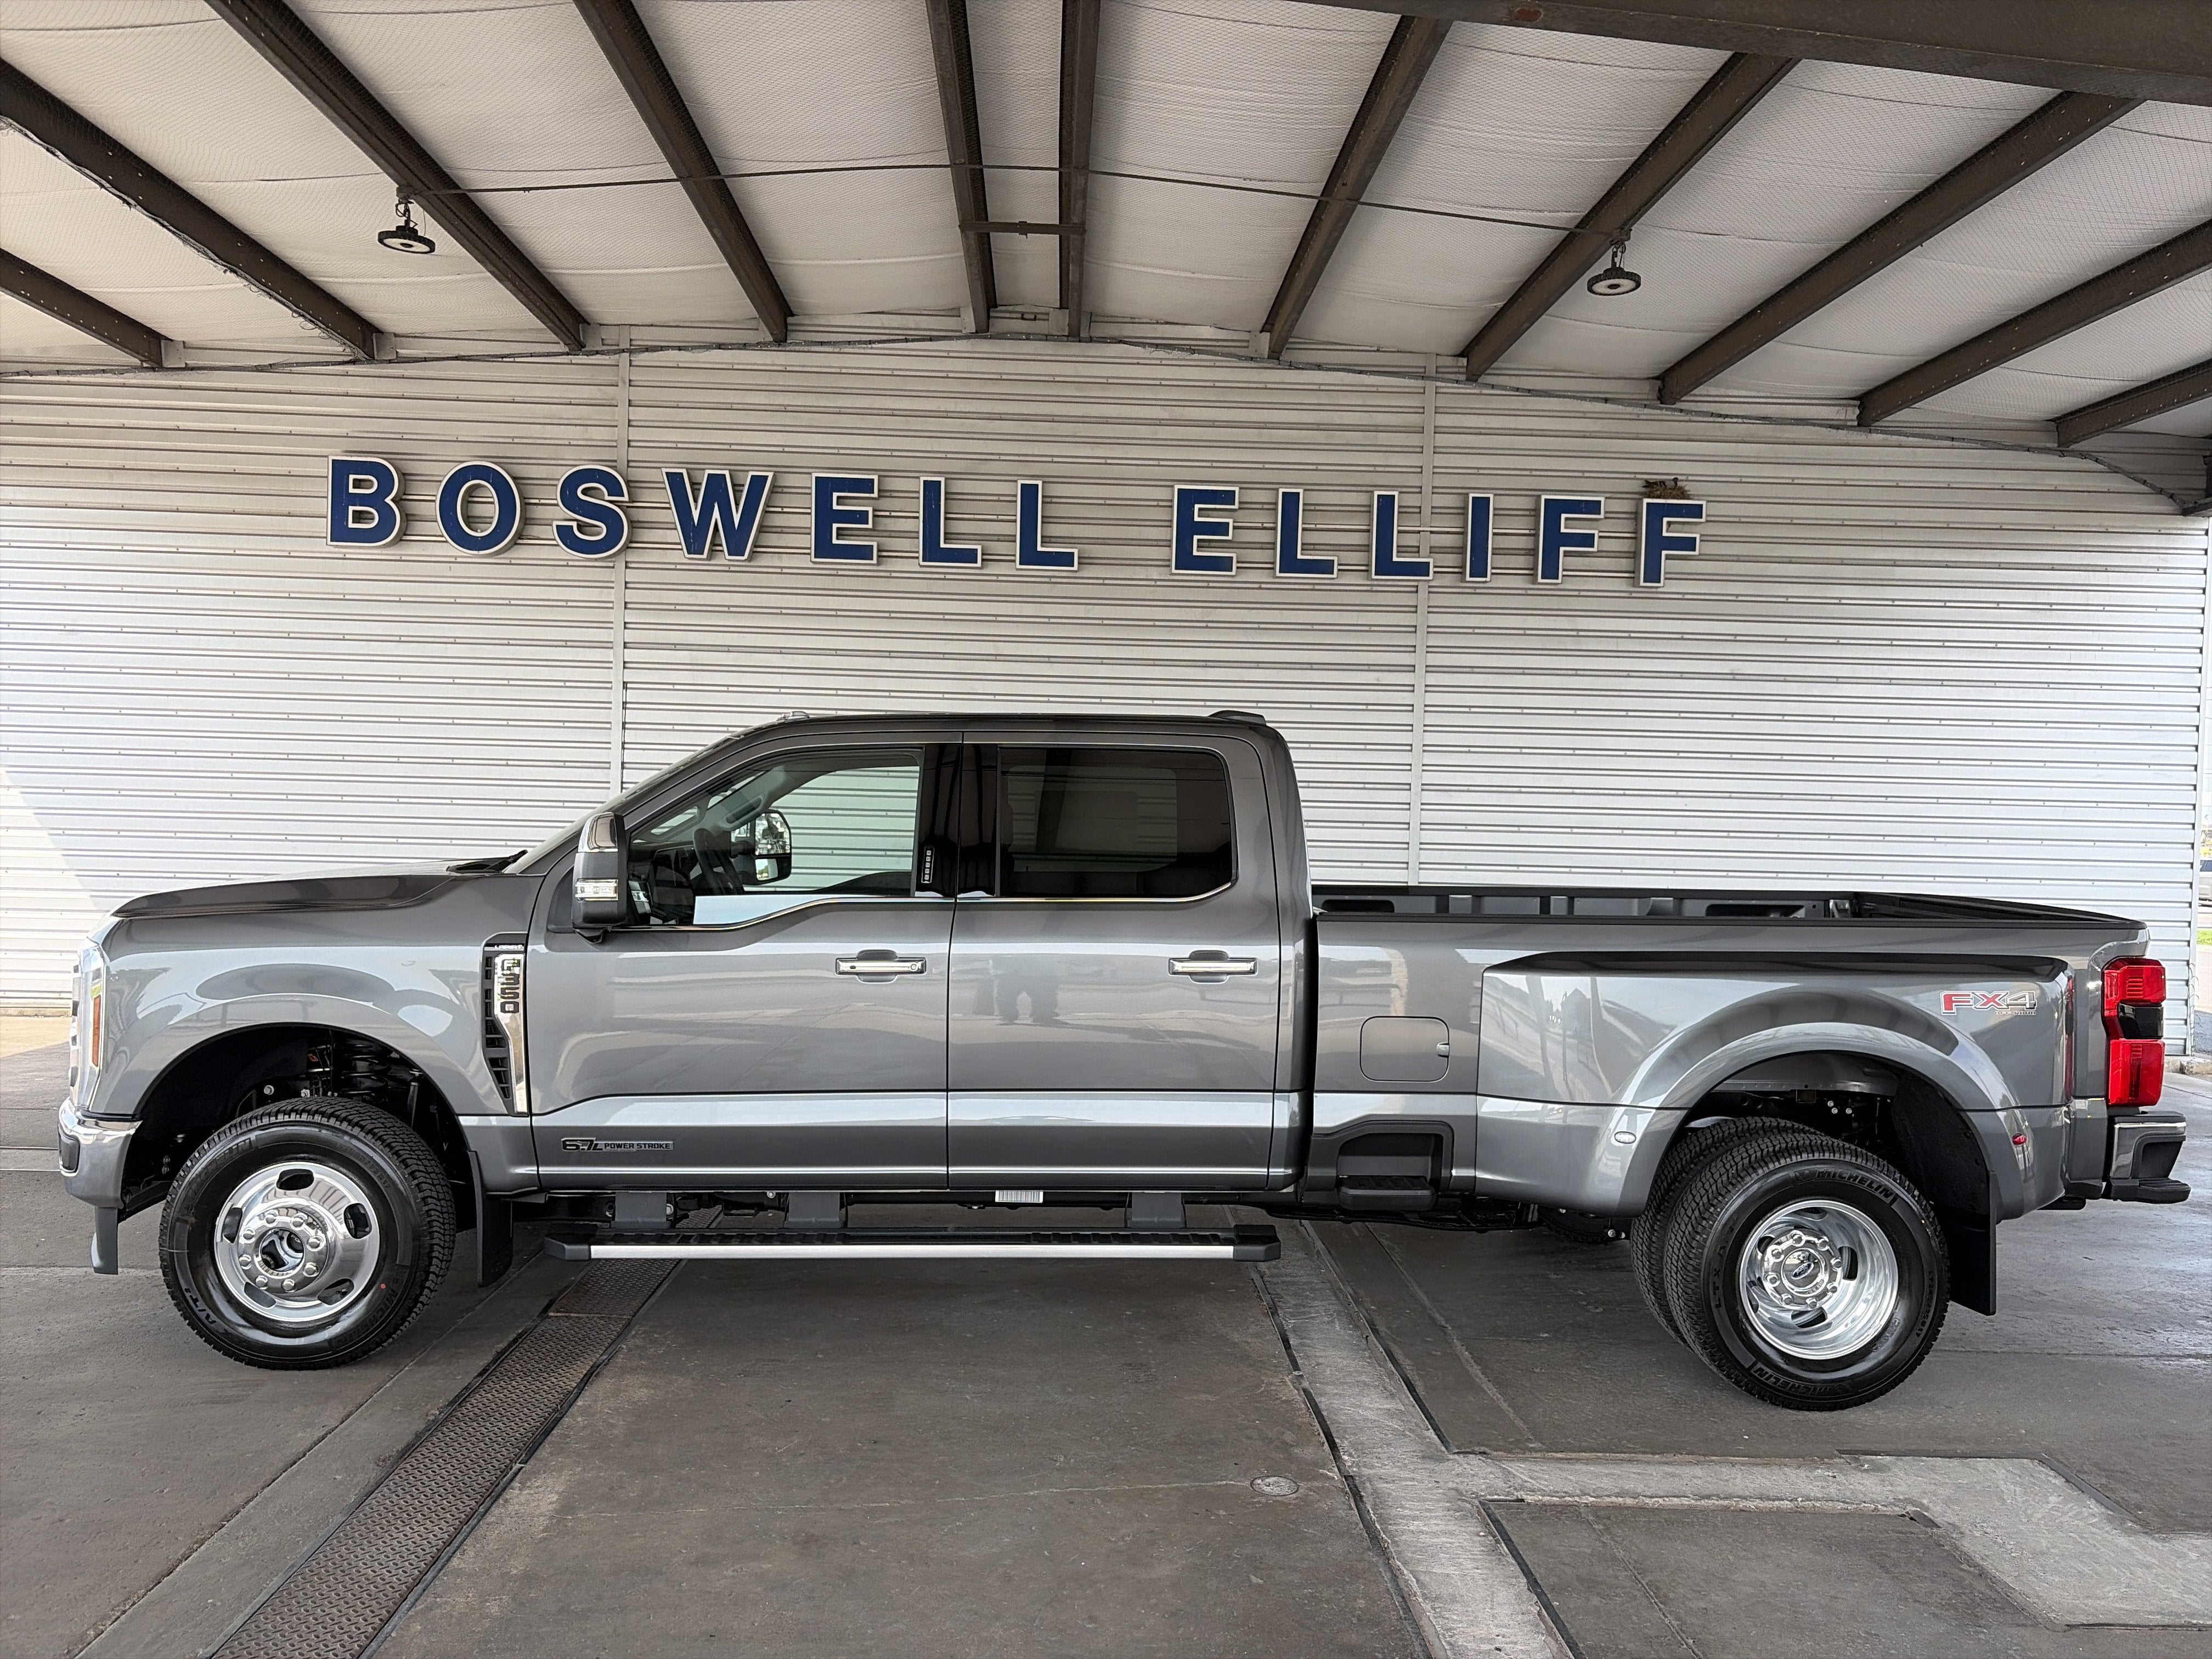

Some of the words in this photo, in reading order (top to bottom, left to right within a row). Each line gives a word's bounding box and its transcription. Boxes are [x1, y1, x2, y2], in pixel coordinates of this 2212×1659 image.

[325, 455, 1079, 571] BOSWELL
[1171, 485, 1706, 587] ELLIFF
[1940, 991, 2037, 1015] FX4
[562, 1138, 603, 1151] 6.7L
[1813, 1169, 1894, 1199] MICHELIN
